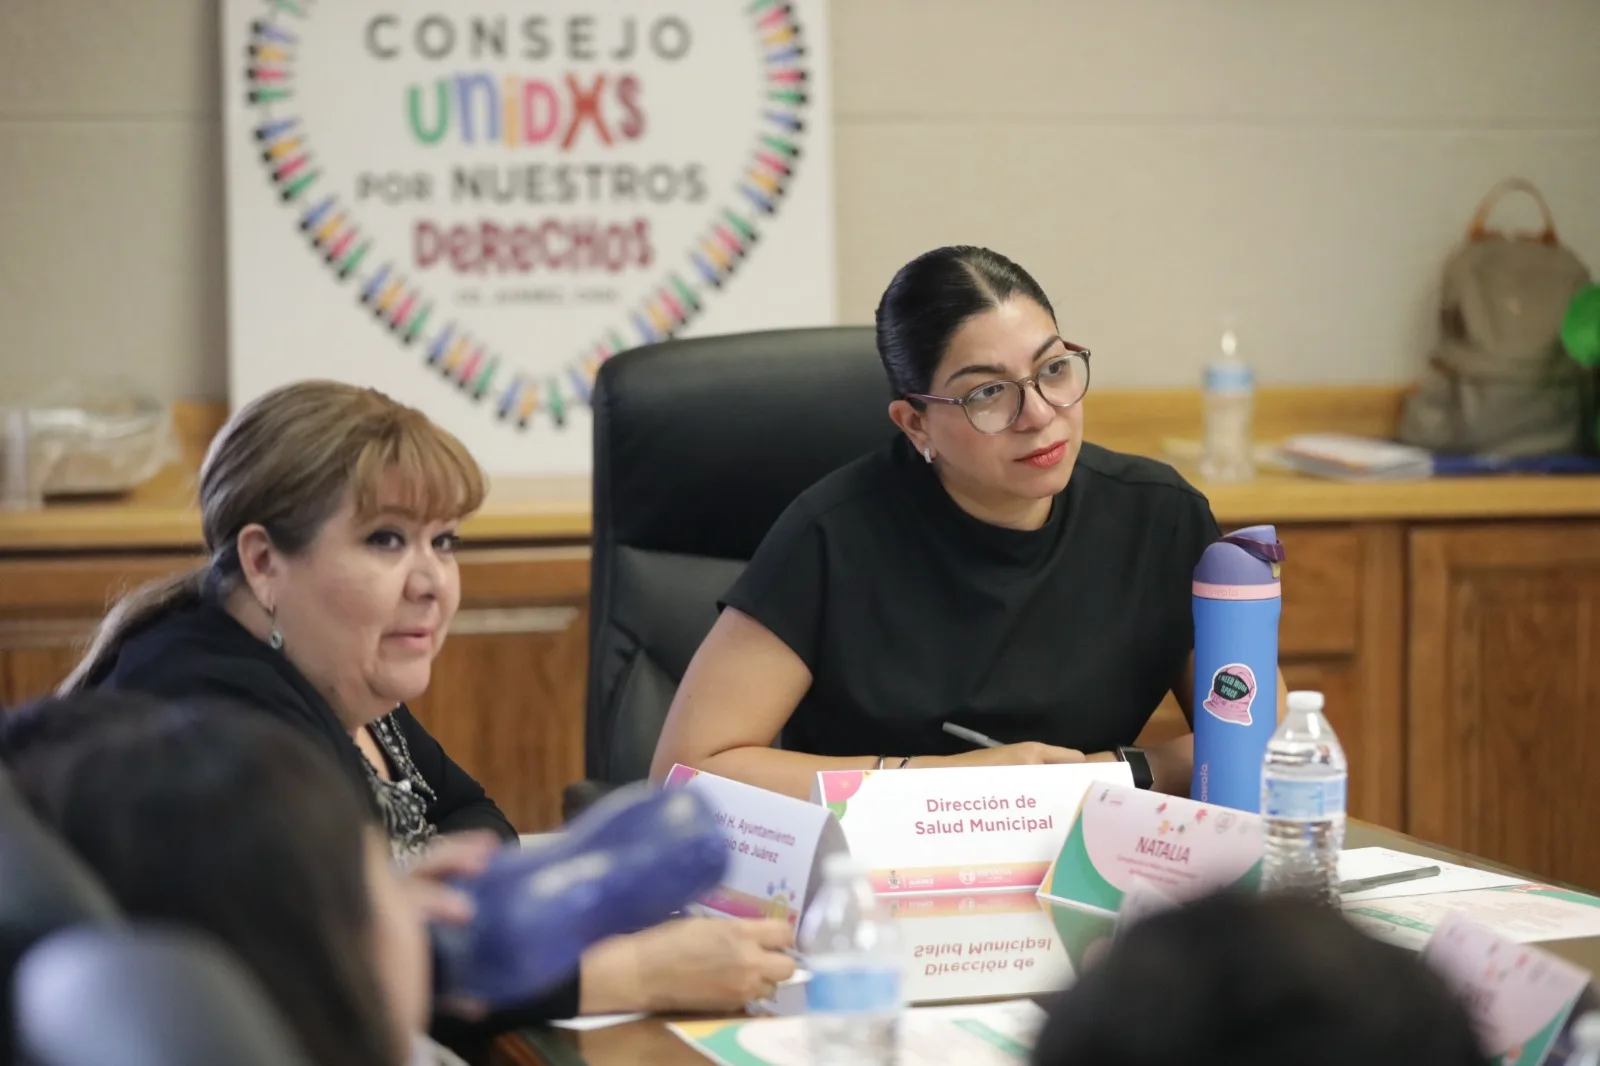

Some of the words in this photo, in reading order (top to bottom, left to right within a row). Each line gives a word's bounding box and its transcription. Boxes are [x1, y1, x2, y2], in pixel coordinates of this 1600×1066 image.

[364, 13, 693, 61] CONSEJO
[354, 169, 434, 205] POR
[450, 163, 709, 205] NUESTROS
[1220, 684, 1238, 699] SPACE
[1221, 674, 1235, 687] NEED
[1233, 678, 1248, 694] MORE
[926, 795, 1010, 813] Dirección
[1015, 795, 1037, 809] de
[738, 818, 796, 847] Ayuntamiento
[915, 819, 964, 835] Salud
[970, 814, 1054, 833] Municipal
[738, 840, 750, 855] de
[750, 843, 779, 864] Juárez
[1135, 835, 1191, 864] NATALIA
